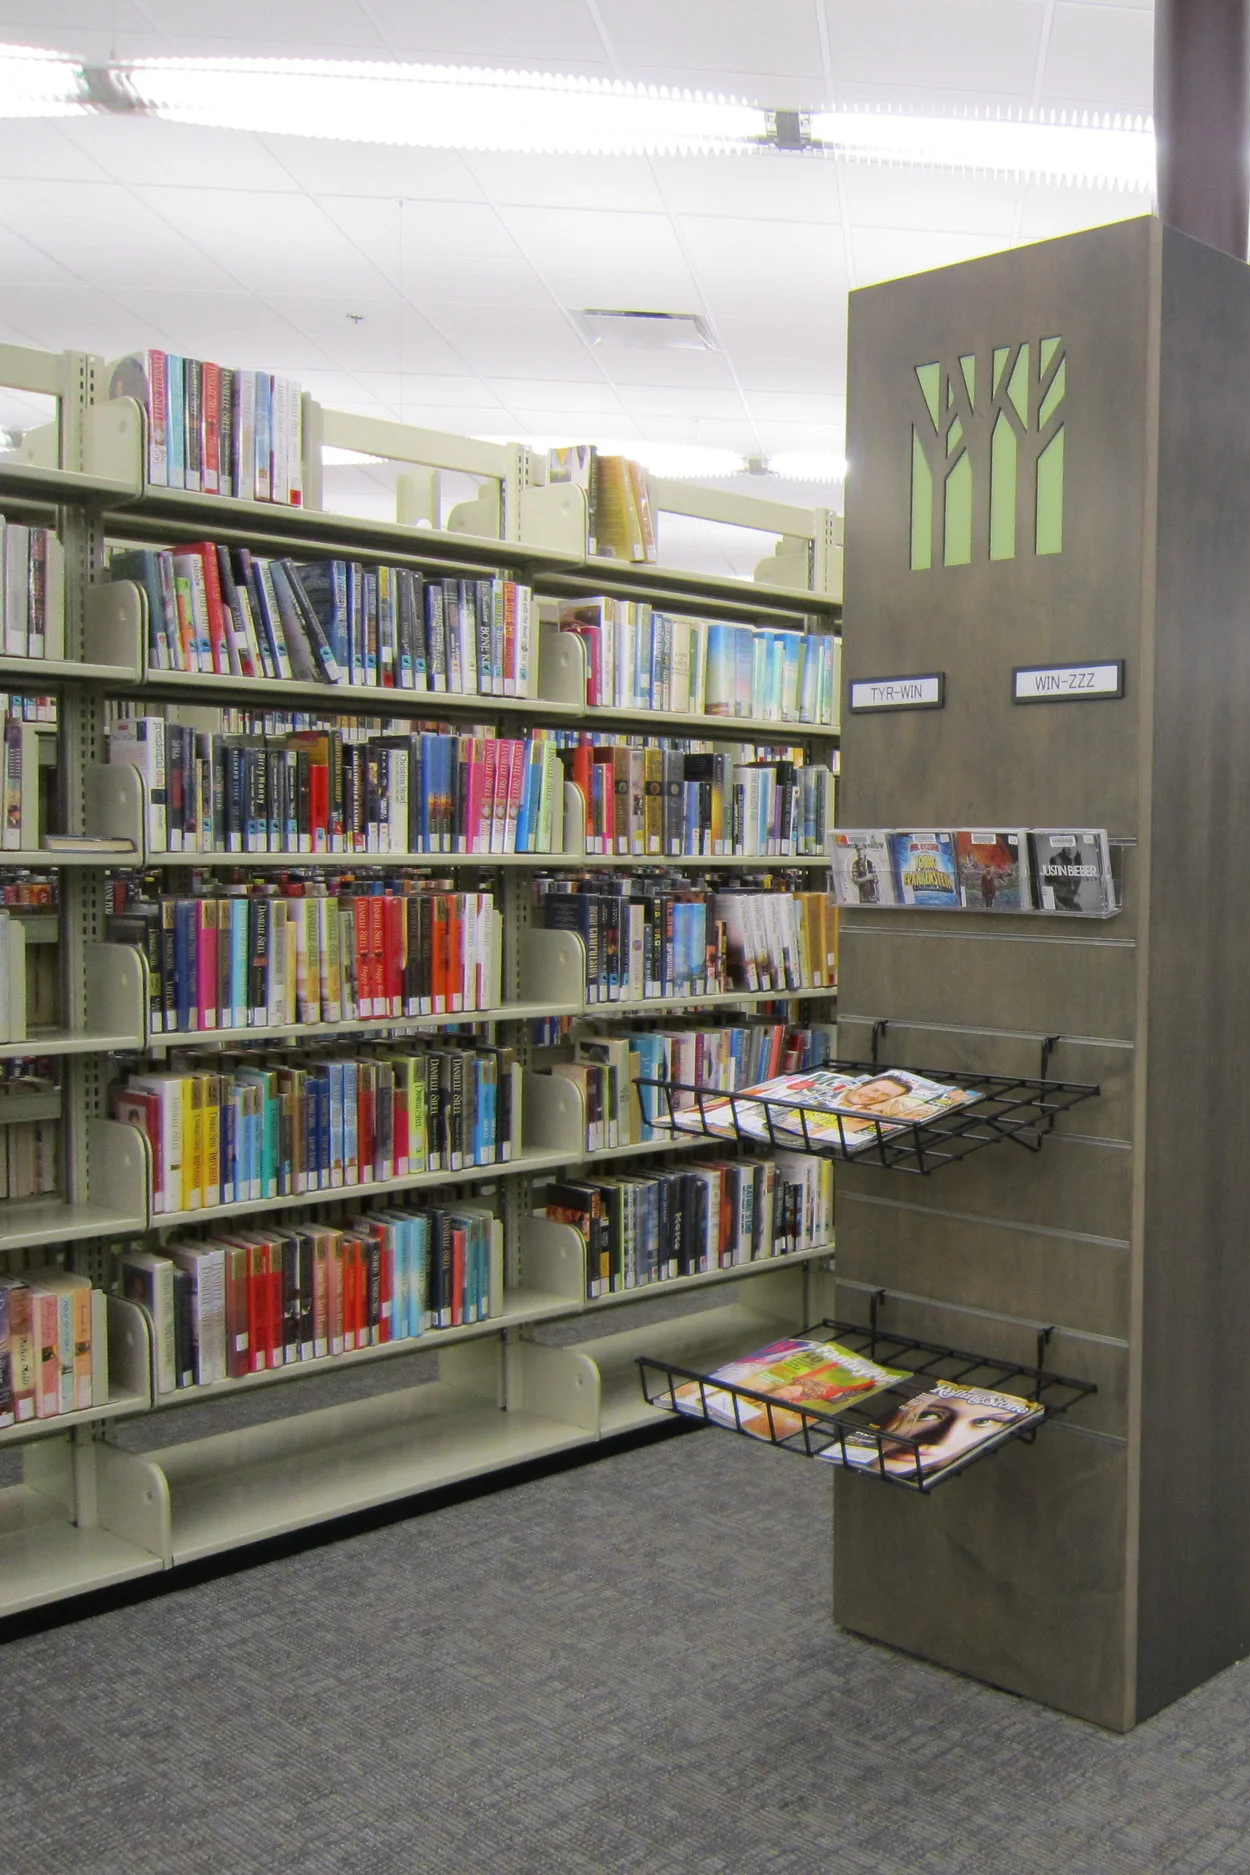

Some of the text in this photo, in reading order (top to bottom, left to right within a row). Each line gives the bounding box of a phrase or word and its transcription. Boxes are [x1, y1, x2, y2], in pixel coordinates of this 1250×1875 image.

[222, 372, 232, 434] DANIELLE STEEL
[480, 626, 490, 651] BONE
[870, 683, 923, 702] TYR-WIN
[1035, 672, 1095, 691] WIN-ZZZ
[153, 722, 164, 769] presidential
[256, 752, 265, 804] Dirty Money
[399, 754, 407, 804] Christina Stead
[485, 743, 495, 798] DANIELLE STEEL
[498, 743, 510, 798] DANIELLE STEEL
[512, 744, 523, 799] DANIELLE STEEL
[1040, 864, 1098, 877] JUSTIN BIEBER
[257, 905, 267, 953] DANIELLE STEEL
[359, 901, 367, 929] DANIELLE
[373, 901, 381, 929] DANIELLE
[429, 1058, 439, 1091] DANIELLE
[452, 1059, 461, 1092] DANIELLE
[430, 1094, 439, 1115] STEEL
[453, 1094, 461, 1115] STEEL
